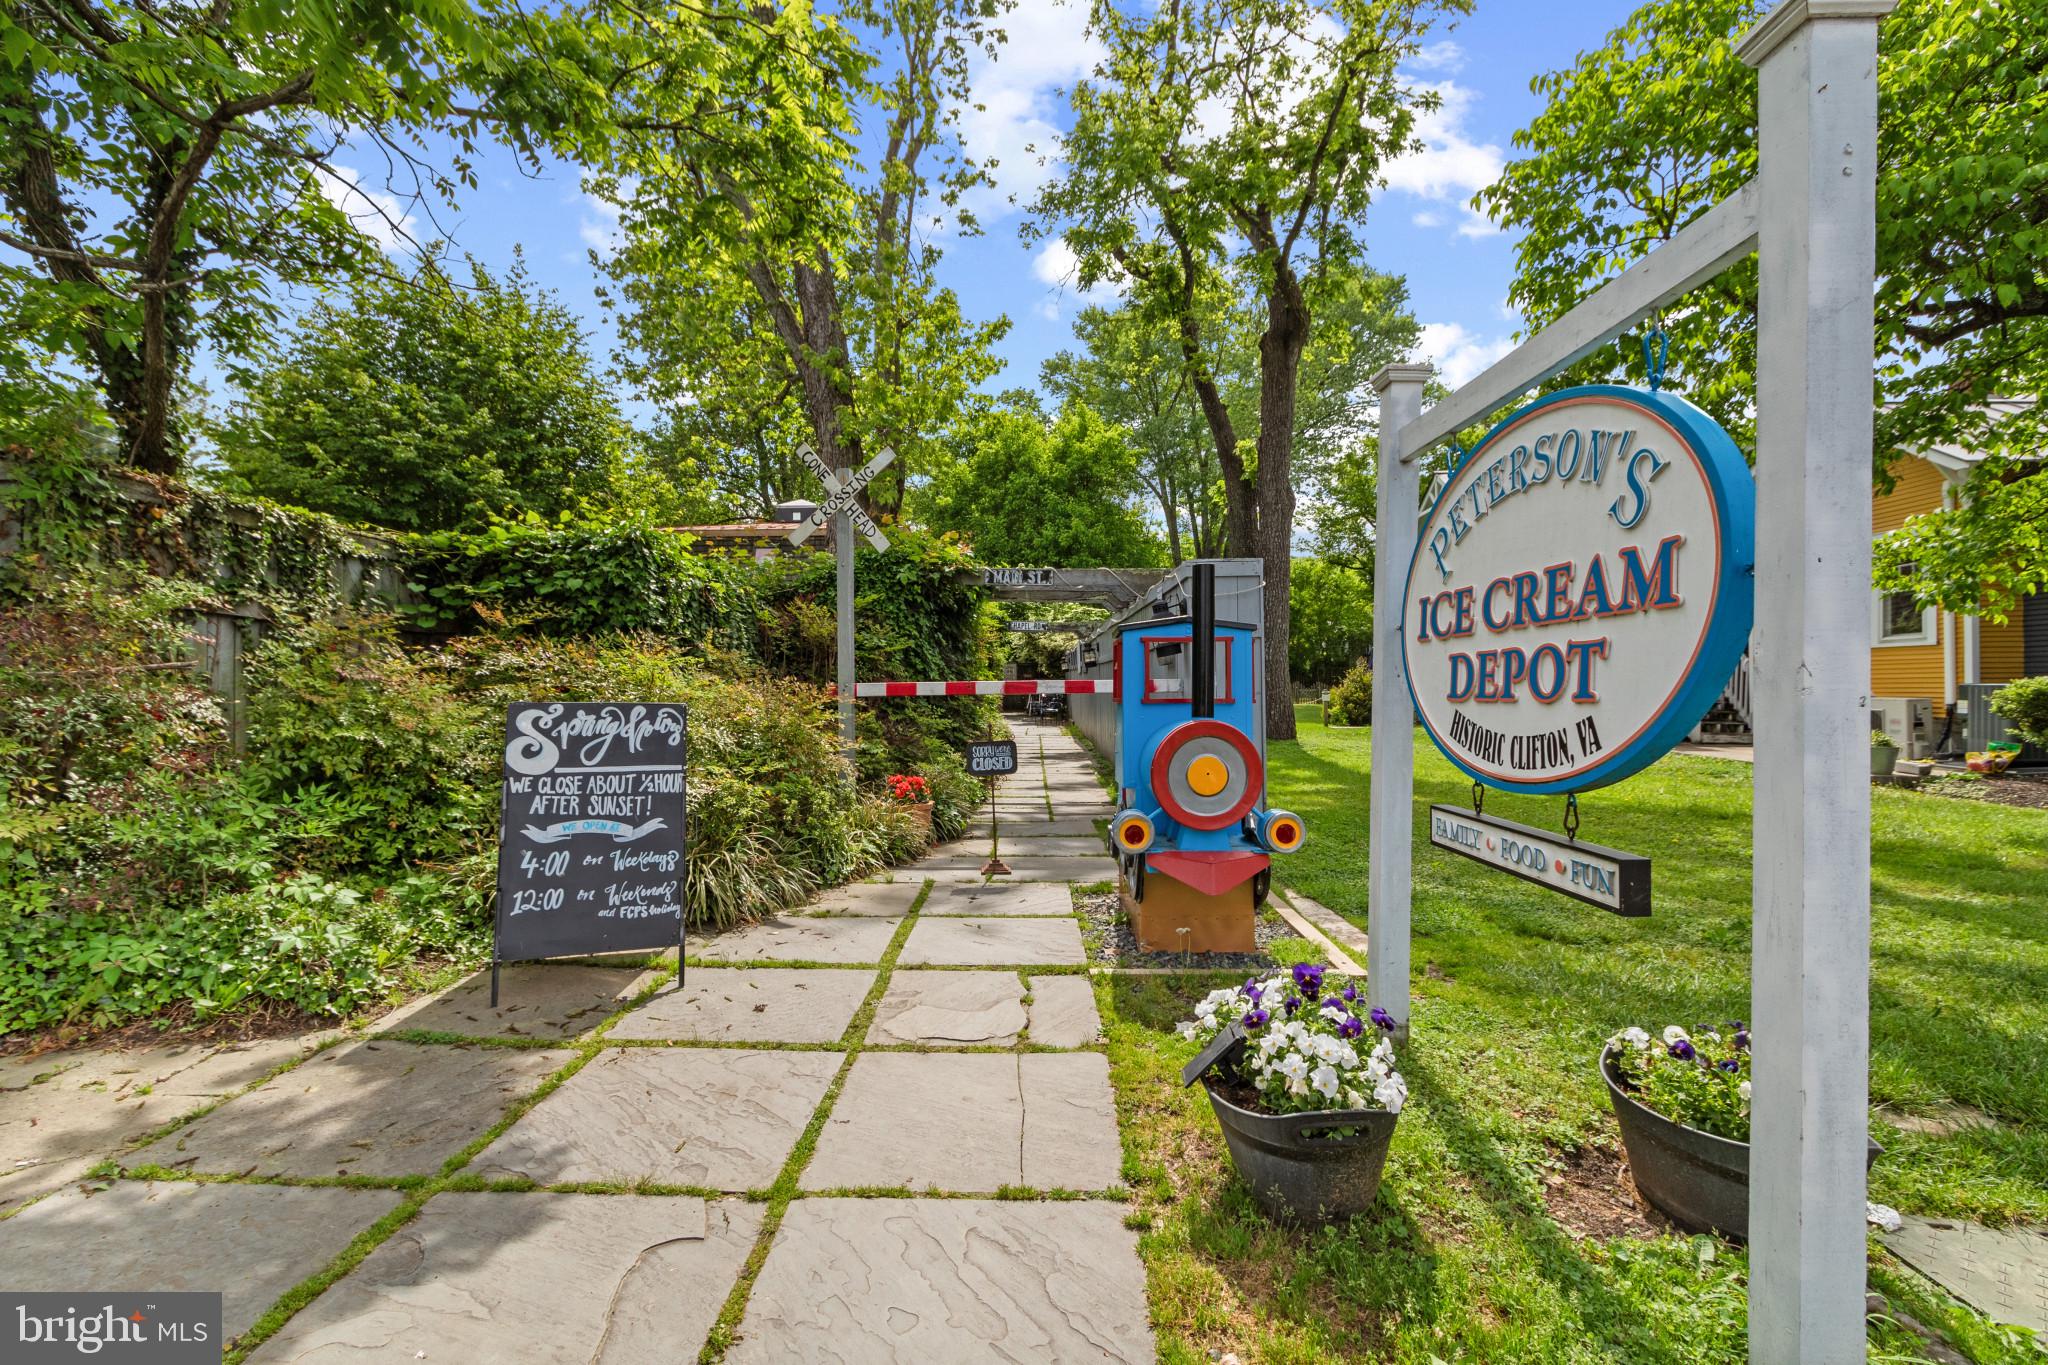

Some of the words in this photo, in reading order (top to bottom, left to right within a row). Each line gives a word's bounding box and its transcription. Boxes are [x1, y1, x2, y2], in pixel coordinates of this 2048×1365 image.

[801, 451, 831, 483] CONE
[845, 503, 876, 538] HEAD
[810, 466, 875, 527] CROSSING
[1428, 428, 1671, 584] PETERSON'S
[1416, 586, 1475, 643] ICE
[1482, 535, 1686, 633] CREAM
[1447, 637, 1610, 704] DEPOT
[506, 704, 625, 775] Spring
[972, 756, 1013, 771] CLOSED
[1450, 709, 1506, 766] HISTORIC
[1510, 727, 1575, 770] CLIFTON,
[1576, 715, 1602, 758] VA
[510, 776, 532, 794] WE
[538, 775, 583, 794] CLOSE
[586, 774, 636, 794] ABOUT
[529, 796, 579, 815] AFTER
[587, 795, 652, 816] SUNSET!
[582, 821, 608, 831] OPEN
[1435, 817, 1483, 850] FAMILY
[1500, 837, 1547, 872] FOOD
[1570, 859, 1615, 896] FUN
[520, 850, 570, 878] 4:00
[510, 888, 564, 916] 12:00
[620, 905, 648, 919] FCPS
